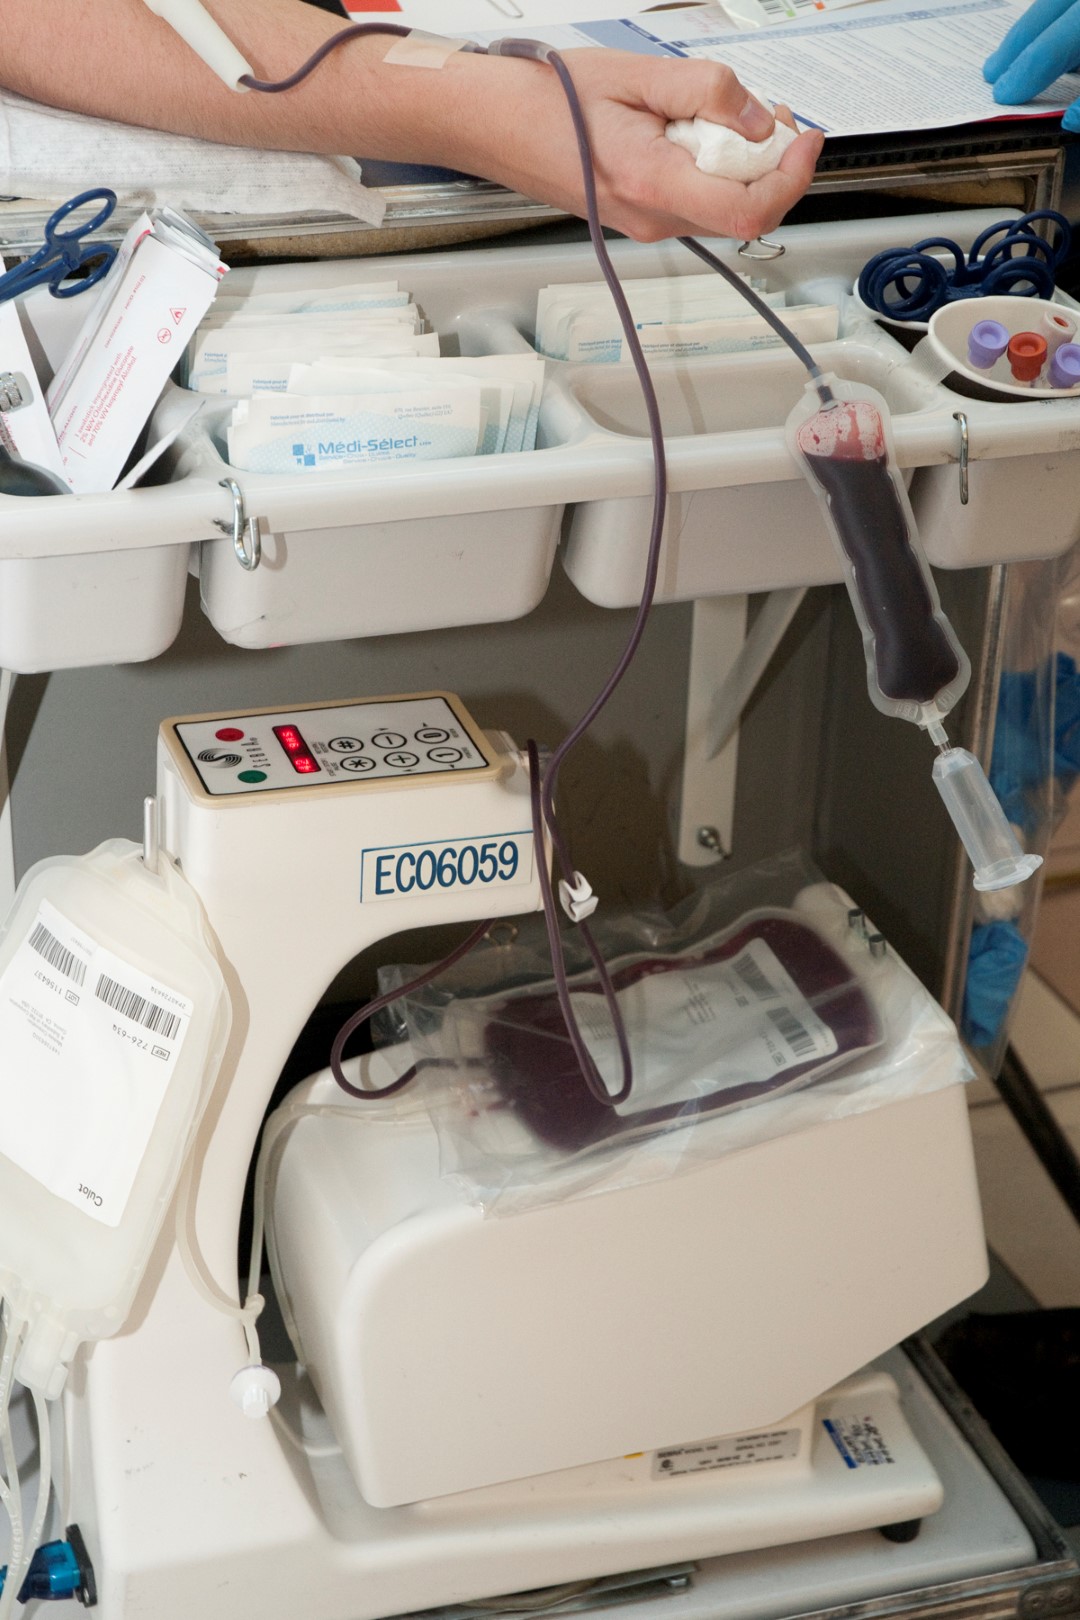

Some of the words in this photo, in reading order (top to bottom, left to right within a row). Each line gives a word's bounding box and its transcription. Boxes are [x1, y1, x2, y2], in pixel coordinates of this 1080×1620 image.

[93, 377, 117, 418] Chlorhexidine
[114, 345, 134, 376] Gluconate
[93, 365, 115, 405] impregnated
[88, 435, 96, 446] and
[94, 420, 103, 434] 70%
[107, 380, 124, 409] Isopropyl
[121, 356, 137, 380] Alcohol
[318, 435, 418, 455] Médi-Sélect
[34, 969, 63, 995] 1156437
[78, 1183, 103, 1207] Culot
